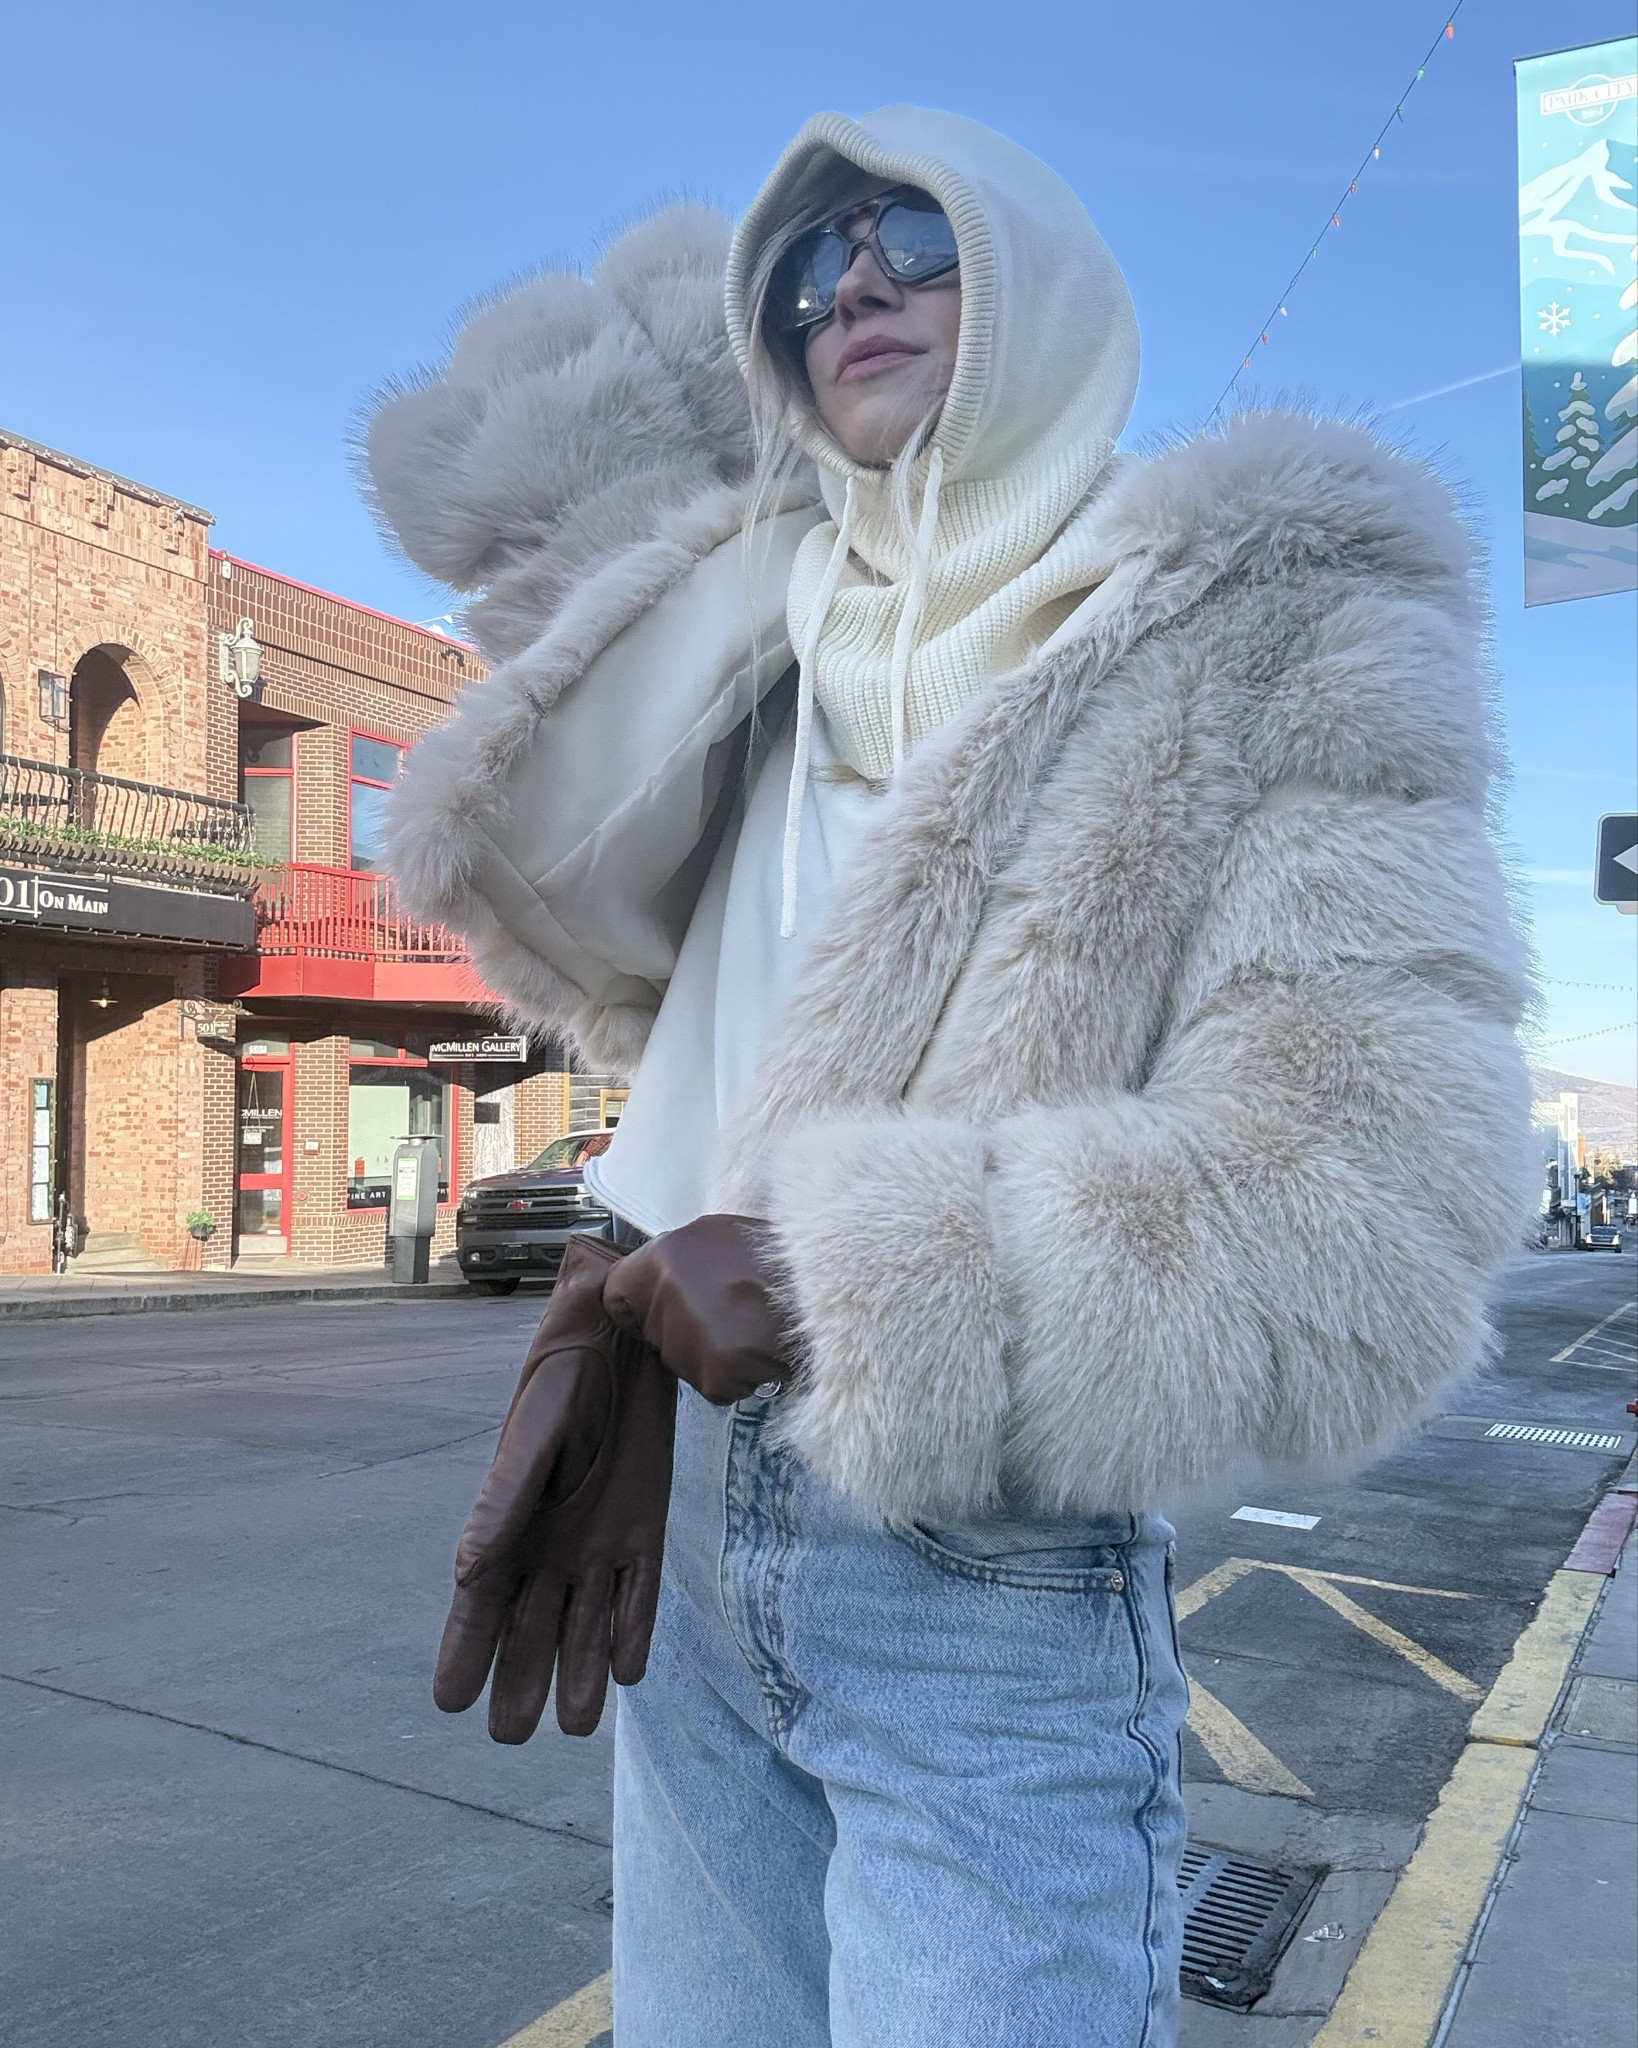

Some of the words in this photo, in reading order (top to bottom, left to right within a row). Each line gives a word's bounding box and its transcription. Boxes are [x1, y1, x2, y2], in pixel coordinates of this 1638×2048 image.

[1549, 91, 1588, 108] PARK
[1594, 81, 1634, 98] CITY
[197, 1023, 214, 1033] 501
[369, 1191, 387, 1199] ART
